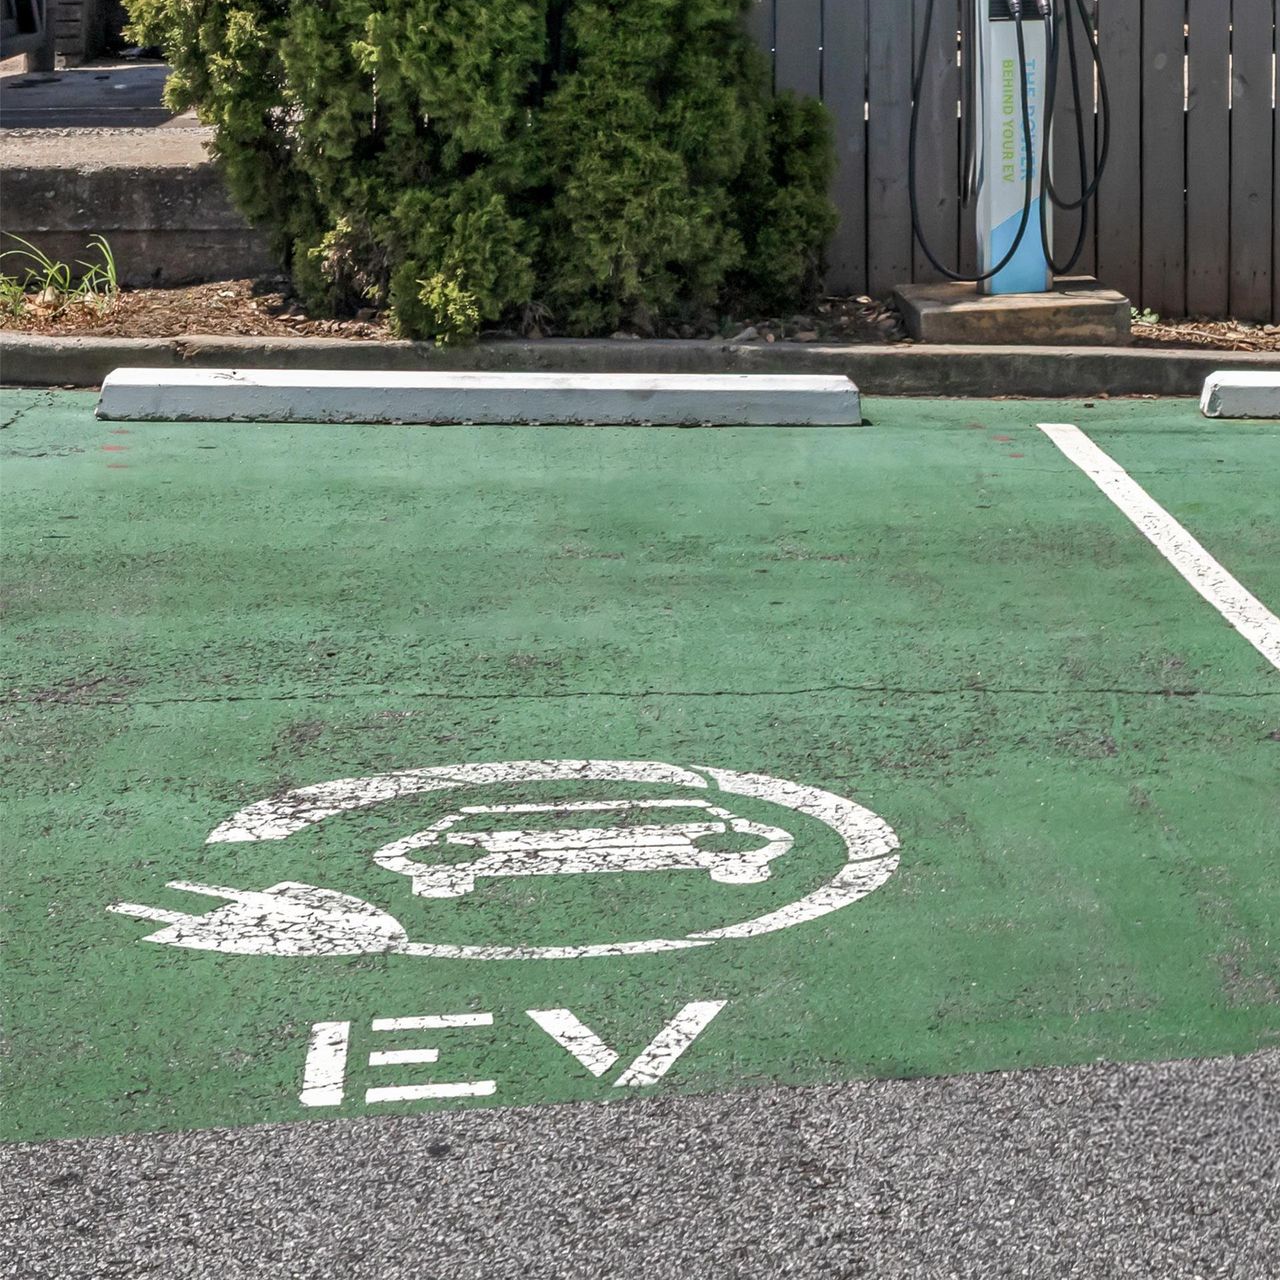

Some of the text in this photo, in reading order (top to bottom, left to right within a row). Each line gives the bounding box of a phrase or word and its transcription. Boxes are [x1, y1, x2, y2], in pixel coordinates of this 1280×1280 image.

[1002, 59, 1014, 183] BEHIND YOUR EV
[299, 1000, 728, 1107] EV
